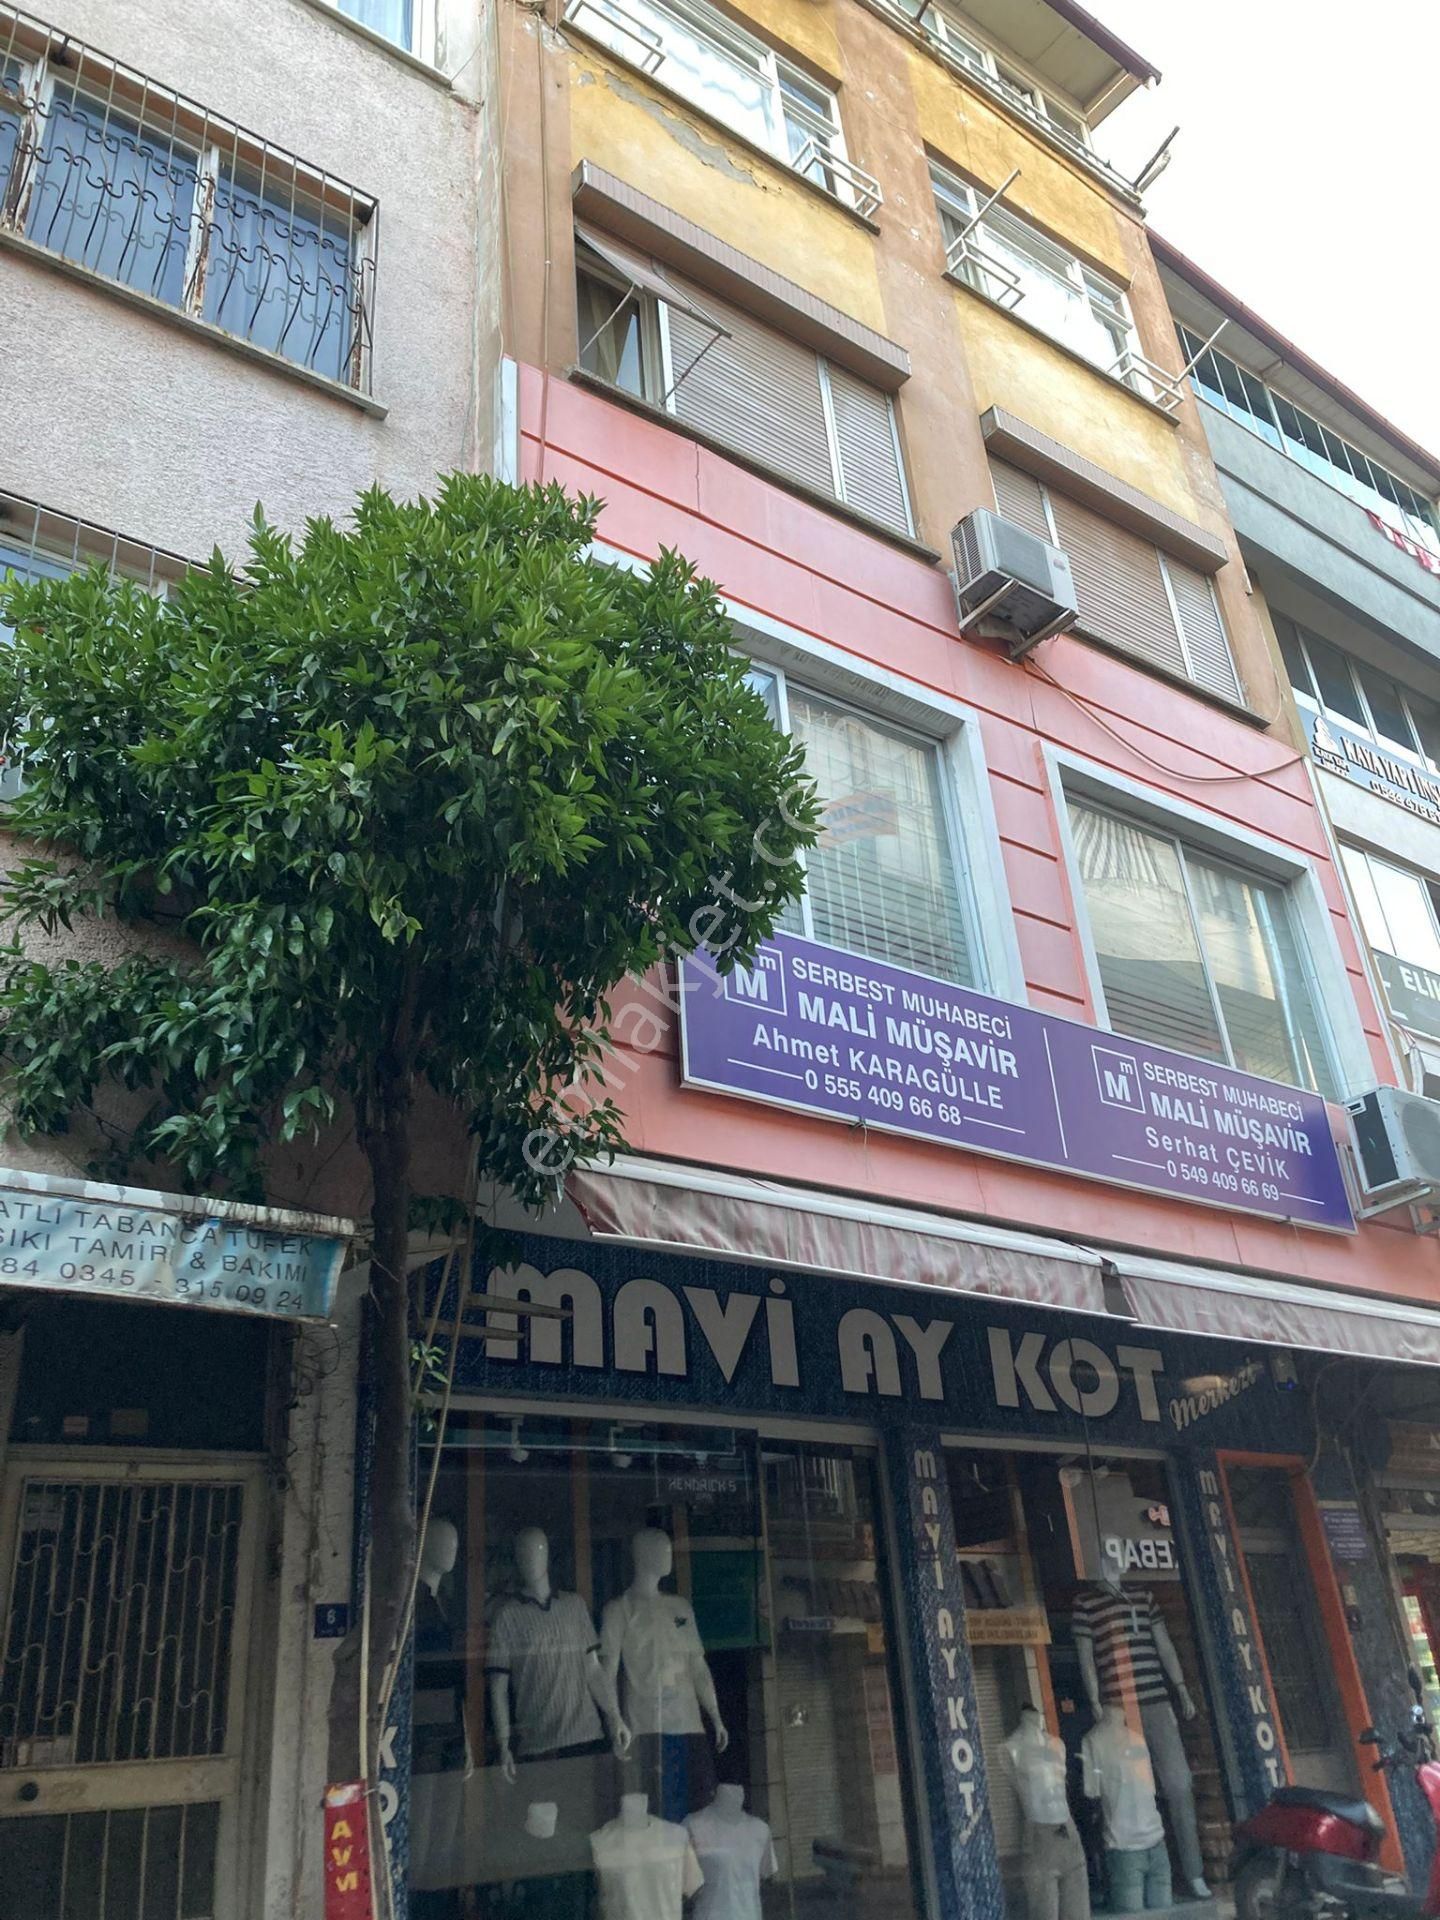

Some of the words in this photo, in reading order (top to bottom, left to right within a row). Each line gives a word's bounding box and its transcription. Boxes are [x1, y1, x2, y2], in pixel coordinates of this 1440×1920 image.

[792, 957, 895, 1006] SERBEST
[901, 989, 1014, 1040] MUHABECİ
[753, 1024, 841, 1068] Ahmet
[848, 1046, 1005, 1110] KARAGÜLLE
[798, 991, 877, 1040] MALİ
[885, 1015, 1020, 1079] MÜŞAVİR
[805, 1067, 819, 1091] 0
[824, 1073, 862, 1102] 555
[868, 1085, 904, 1112] 409
[909, 1095, 934, 1120] 66
[938, 1101, 962, 1126] 68
[1142, 1062, 1219, 1099] SERBEST
[1222, 1085, 1305, 1124] MUHABECİ
[1149, 1091, 1210, 1130] MALİ
[1214, 1106, 1313, 1157] MÜŞAVİR
[1145, 1126, 1219, 1164] Serhat
[1228, 1147, 1290, 1181] ÇEVİK
[1167, 1160, 1177, 1178] 0
[1180, 1163, 1209, 1185] 549
[1211, 1170, 1239, 1193] 409
[1241, 1180, 1260, 1198] 66
[1261, 1183, 1280, 1202] 69
[68, 1236, 168, 1262] TAMİR
[190, 1251, 206, 1271] &
[222, 1254, 308, 1283] BAKIMI
[74, 1209, 217, 1246] TABANCA
[59, 1262, 136, 1286] 0345
[175, 1277, 224, 1299] 315
[235, 1284, 267, 1305] 09
[276, 1290, 303, 1310] 24
[838, 1308, 954, 1401] AY
[987, 1326, 1165, 1422] KOT
[947, 1696, 977, 1816] KOT
[1248, 1685, 1281, 1788] KOT
